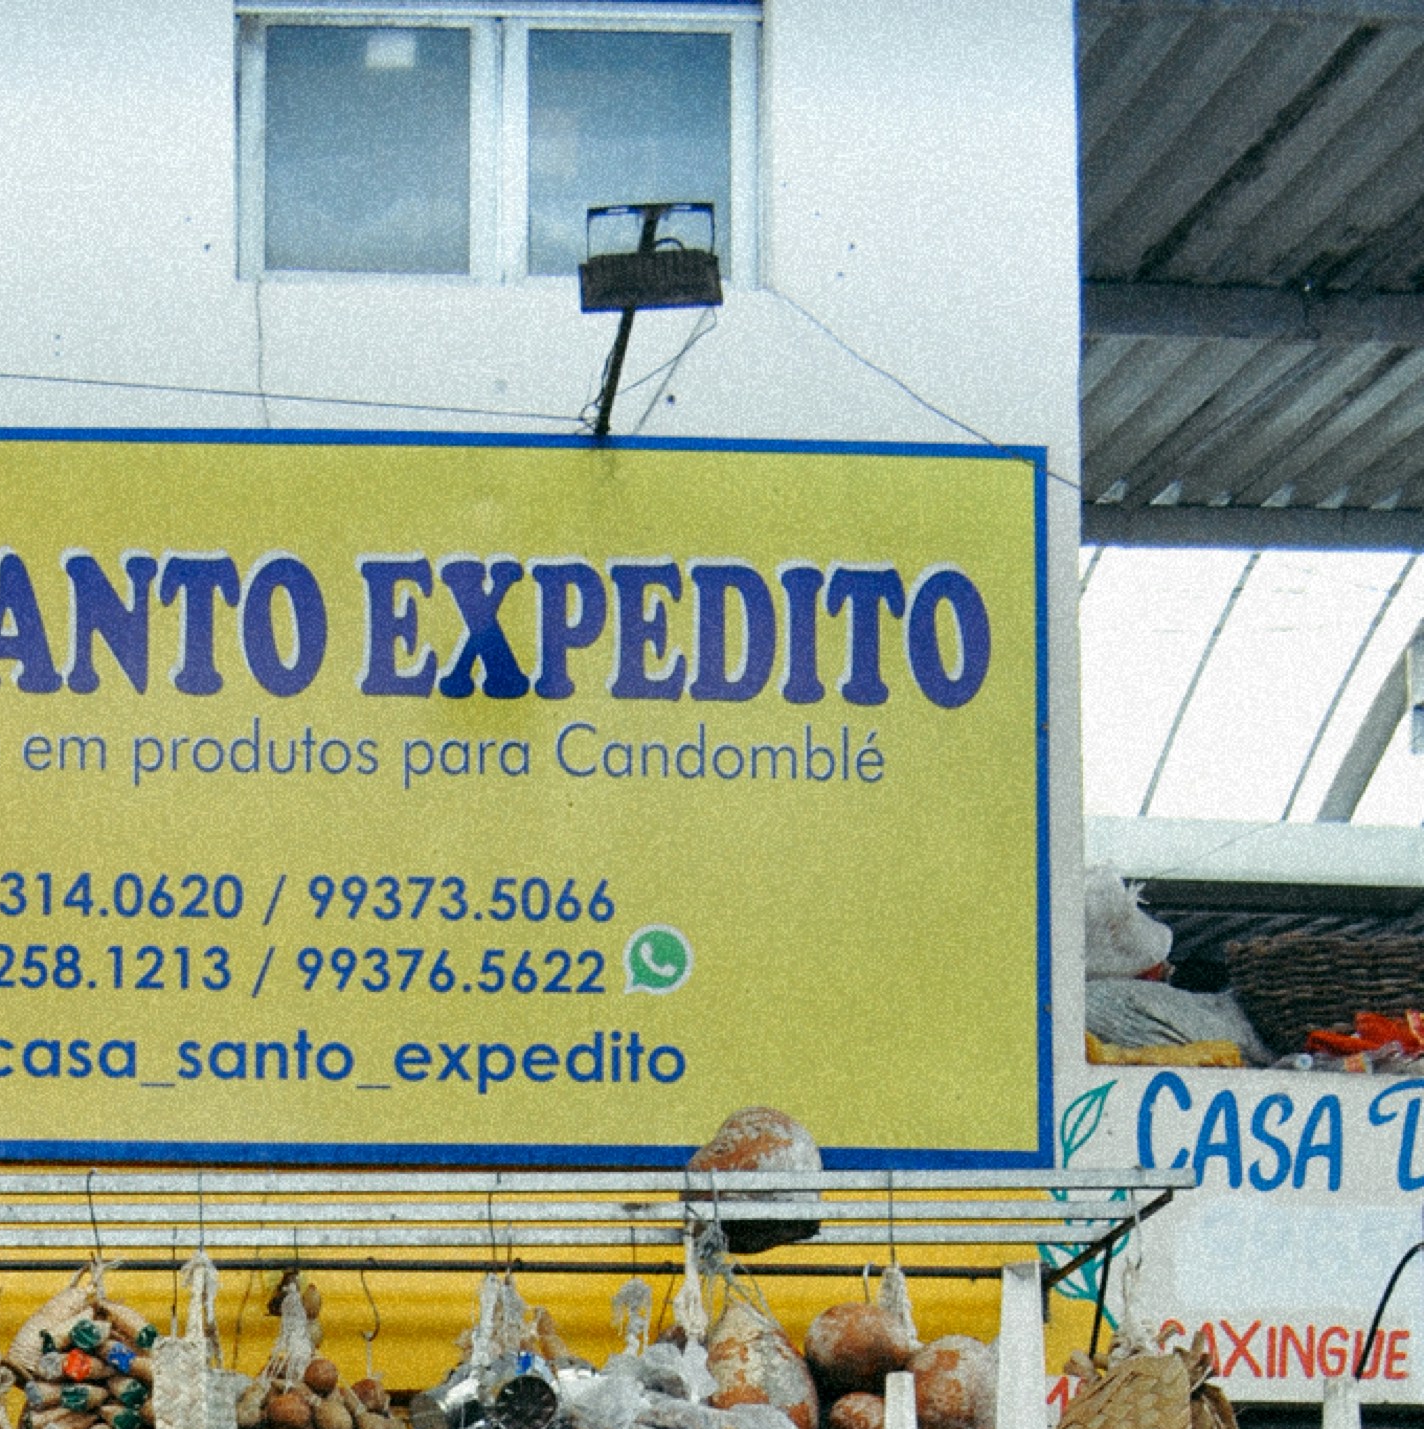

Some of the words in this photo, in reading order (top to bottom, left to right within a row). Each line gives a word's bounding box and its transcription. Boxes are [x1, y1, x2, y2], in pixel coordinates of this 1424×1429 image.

[356, 552, 992, 709] EXPEDITO
[22, 735, 107, 770] em
[133, 718, 379, 786] produtos
[403, 739, 530, 788] para
[555, 721, 886, 783] Candomblé
[308, 874, 616, 922] 99373.5066
[297, 947, 606, 994] 99376.5622
[1136, 1071, 1344, 1193] CASA
